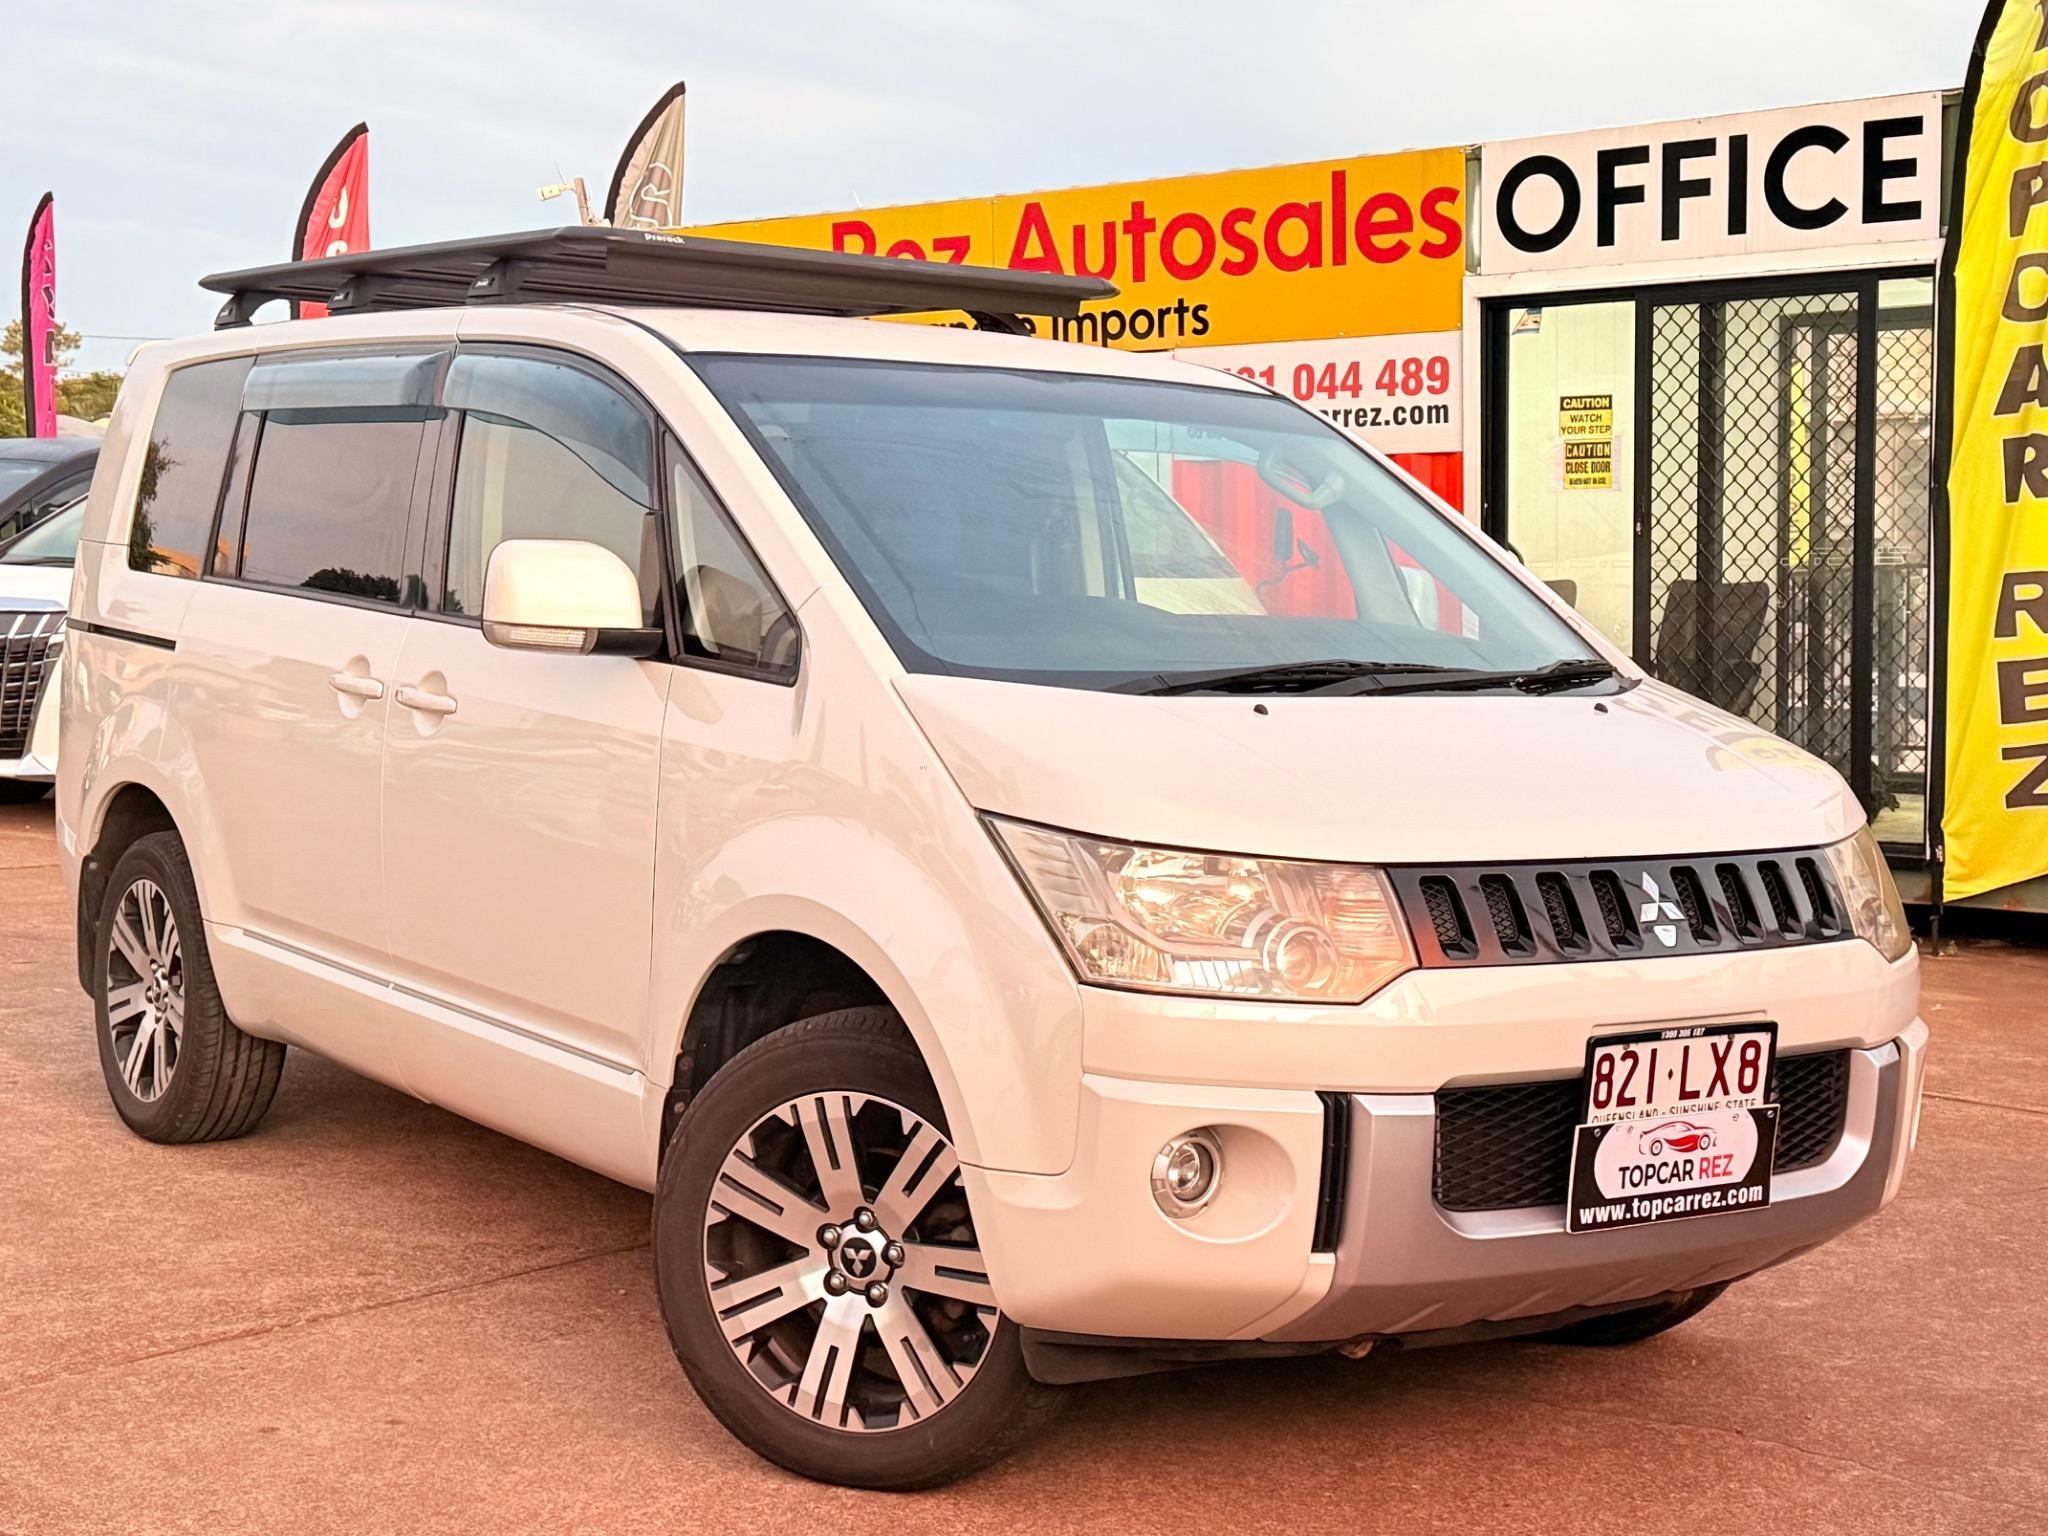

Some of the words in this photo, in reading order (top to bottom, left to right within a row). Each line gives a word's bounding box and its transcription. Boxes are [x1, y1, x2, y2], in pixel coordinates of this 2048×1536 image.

[1496, 115, 1923, 253] OFFICE
[1008, 170, 1463, 283] Autosales
[1293, 361, 1363, 401] 044
[1375, 355, 1449, 396] 489
[1563, 397, 1610, 409] CAUTION
[1570, 413, 1603, 423] WATCH
[1561, 426, 1587, 435] YOUR
[1588, 425, 1612, 434] STEP
[1566, 444, 1611, 457] CAUTION
[1566, 461, 1589, 474] CLOSE
[1591, 460, 1611, 473] DOOR
[1669, 1102, 1720, 1115] SUNSHINE
[1725, 1098, 1757, 1109] STATE
[1618, 1159, 1694, 1189] TOPCAR
[1699, 1154, 1734, 1179] REZ
[1579, 1185, 1763, 1225] www.topcarrez.com
